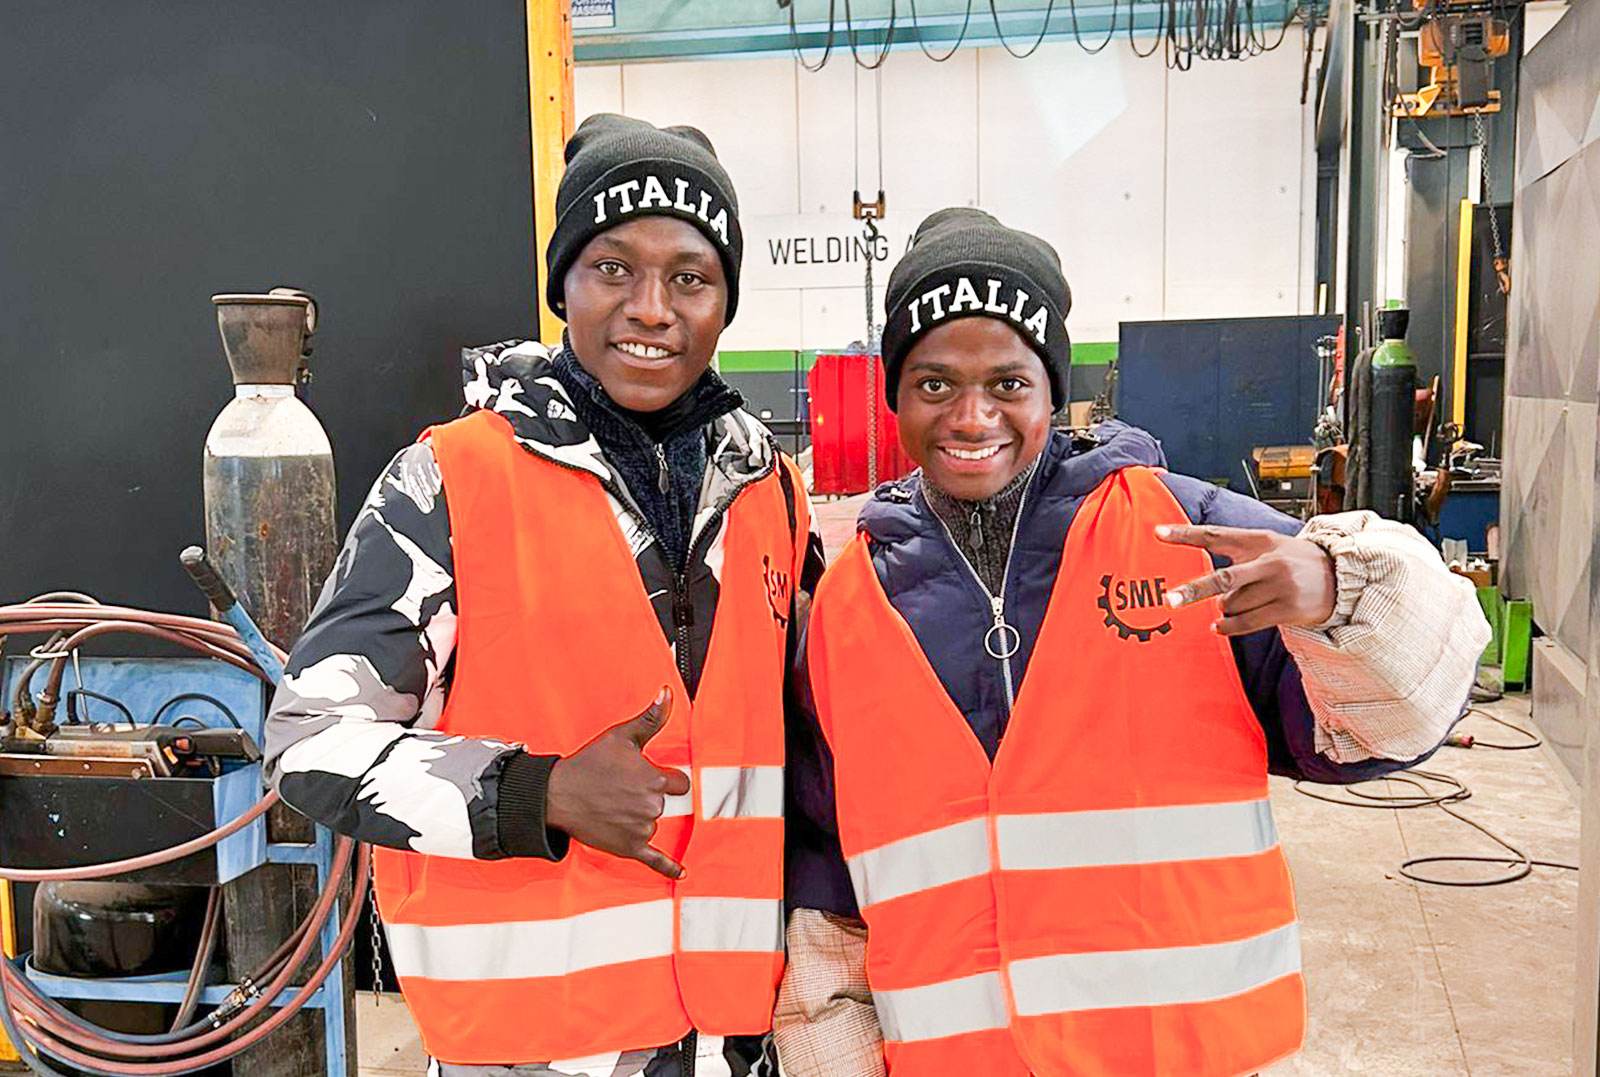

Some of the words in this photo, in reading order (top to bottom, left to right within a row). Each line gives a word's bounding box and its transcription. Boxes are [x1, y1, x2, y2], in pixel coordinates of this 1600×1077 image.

[593, 175, 729, 245] ITALIA
[769, 236, 888, 264] WELDING
[908, 277, 1048, 344] ITALIA
[1116, 577, 1167, 611] SMF
